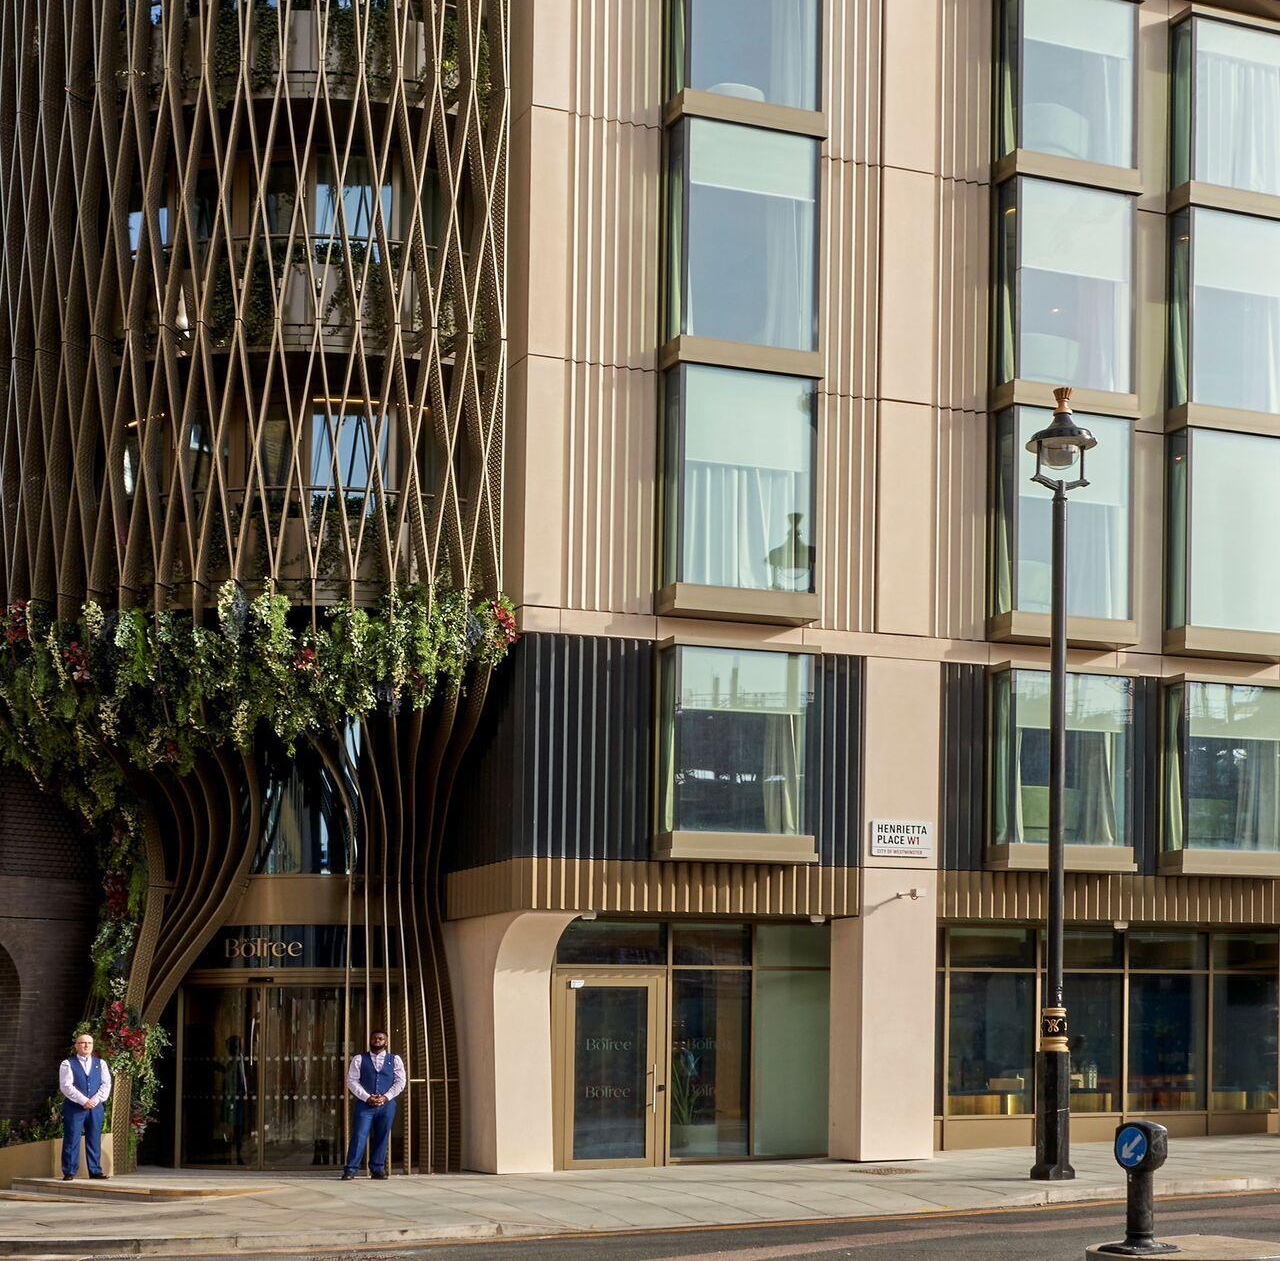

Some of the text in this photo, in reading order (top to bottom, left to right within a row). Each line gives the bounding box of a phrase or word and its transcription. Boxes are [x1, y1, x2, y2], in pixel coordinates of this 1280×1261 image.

[877, 824, 927, 834] HENRIETTA
[877, 835, 920, 845] PLACE W1
